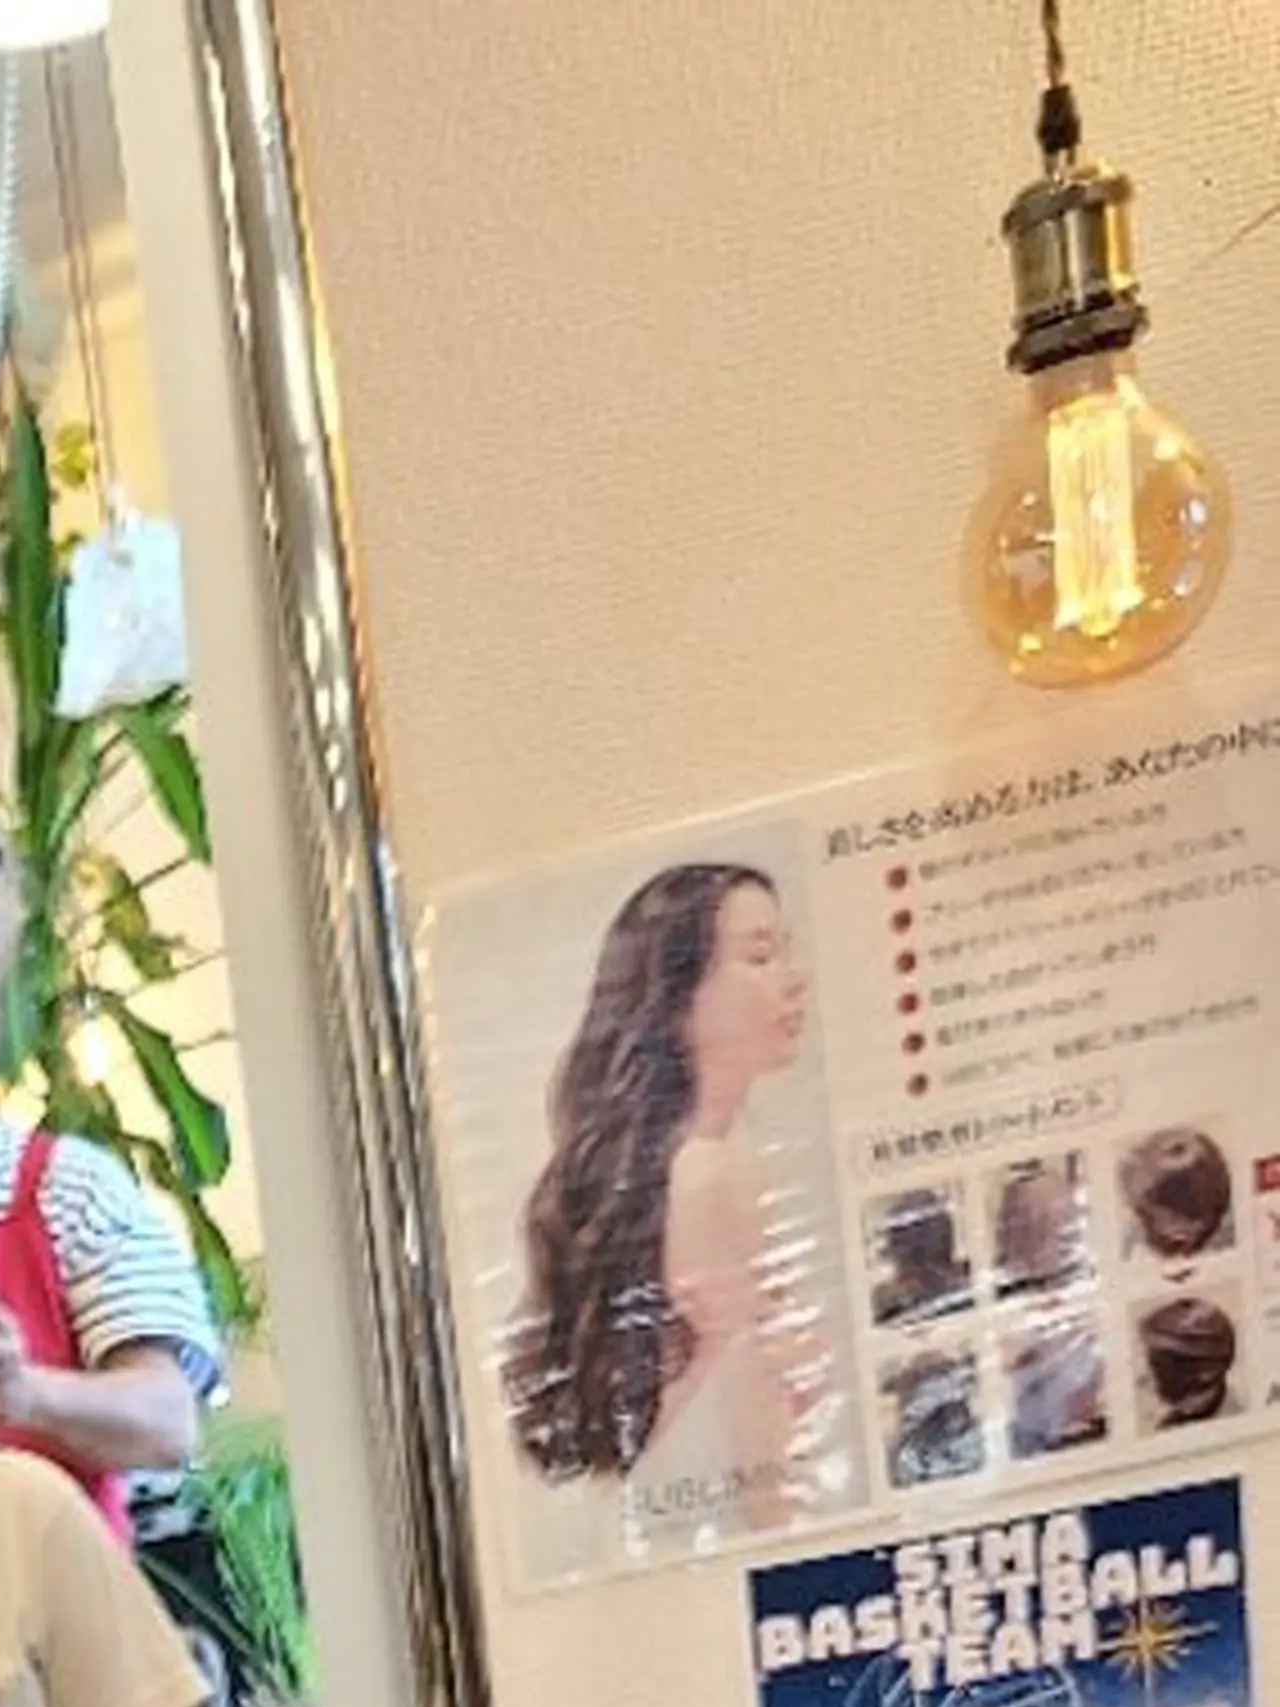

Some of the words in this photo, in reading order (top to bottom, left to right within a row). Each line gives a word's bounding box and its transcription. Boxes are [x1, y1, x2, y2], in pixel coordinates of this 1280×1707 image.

[894, 1510, 1093, 1596] SIMA
[757, 1534, 1239, 1673] BASKETBALL
[904, 1608, 1097, 1693] TEAM
